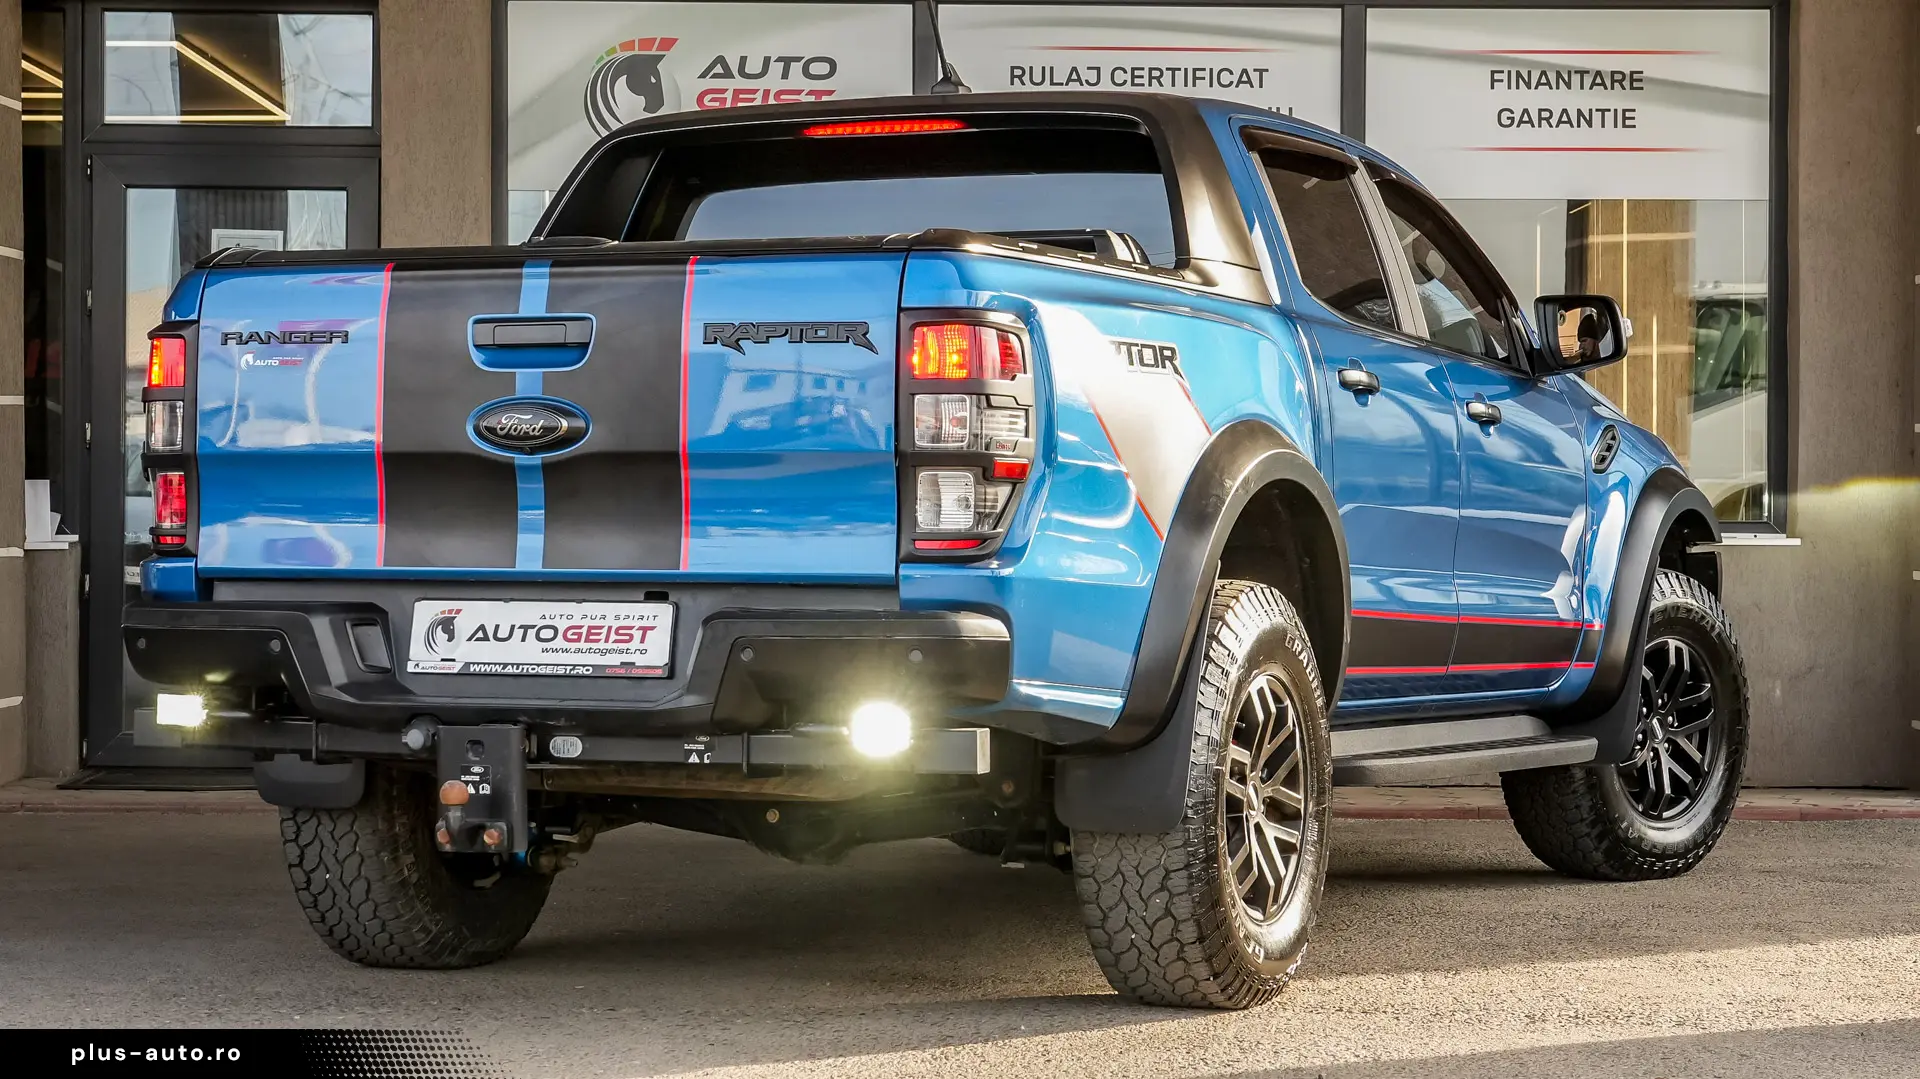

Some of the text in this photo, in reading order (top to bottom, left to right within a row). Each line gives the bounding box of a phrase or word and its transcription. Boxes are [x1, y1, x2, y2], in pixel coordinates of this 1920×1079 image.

[697, 55, 837, 80] AUTO
[1009, 66, 1269, 88] RULAJ CERTIFICAT
[1490, 70, 1644, 90] FINANTARE
[1497, 108, 1637, 128] GARANTIE
[220, 330, 349, 345] RANGER
[702, 321, 879, 356] RAPTOR
[496, 413, 545, 436] Ford
[539, 613, 574, 621] AUTO
[1653, 604, 1721, 644] ENERAL
[541, 646, 648, 657] www.autogeist.ro
[469, 663, 593, 675] WWW.AUTOGEIST.RO
